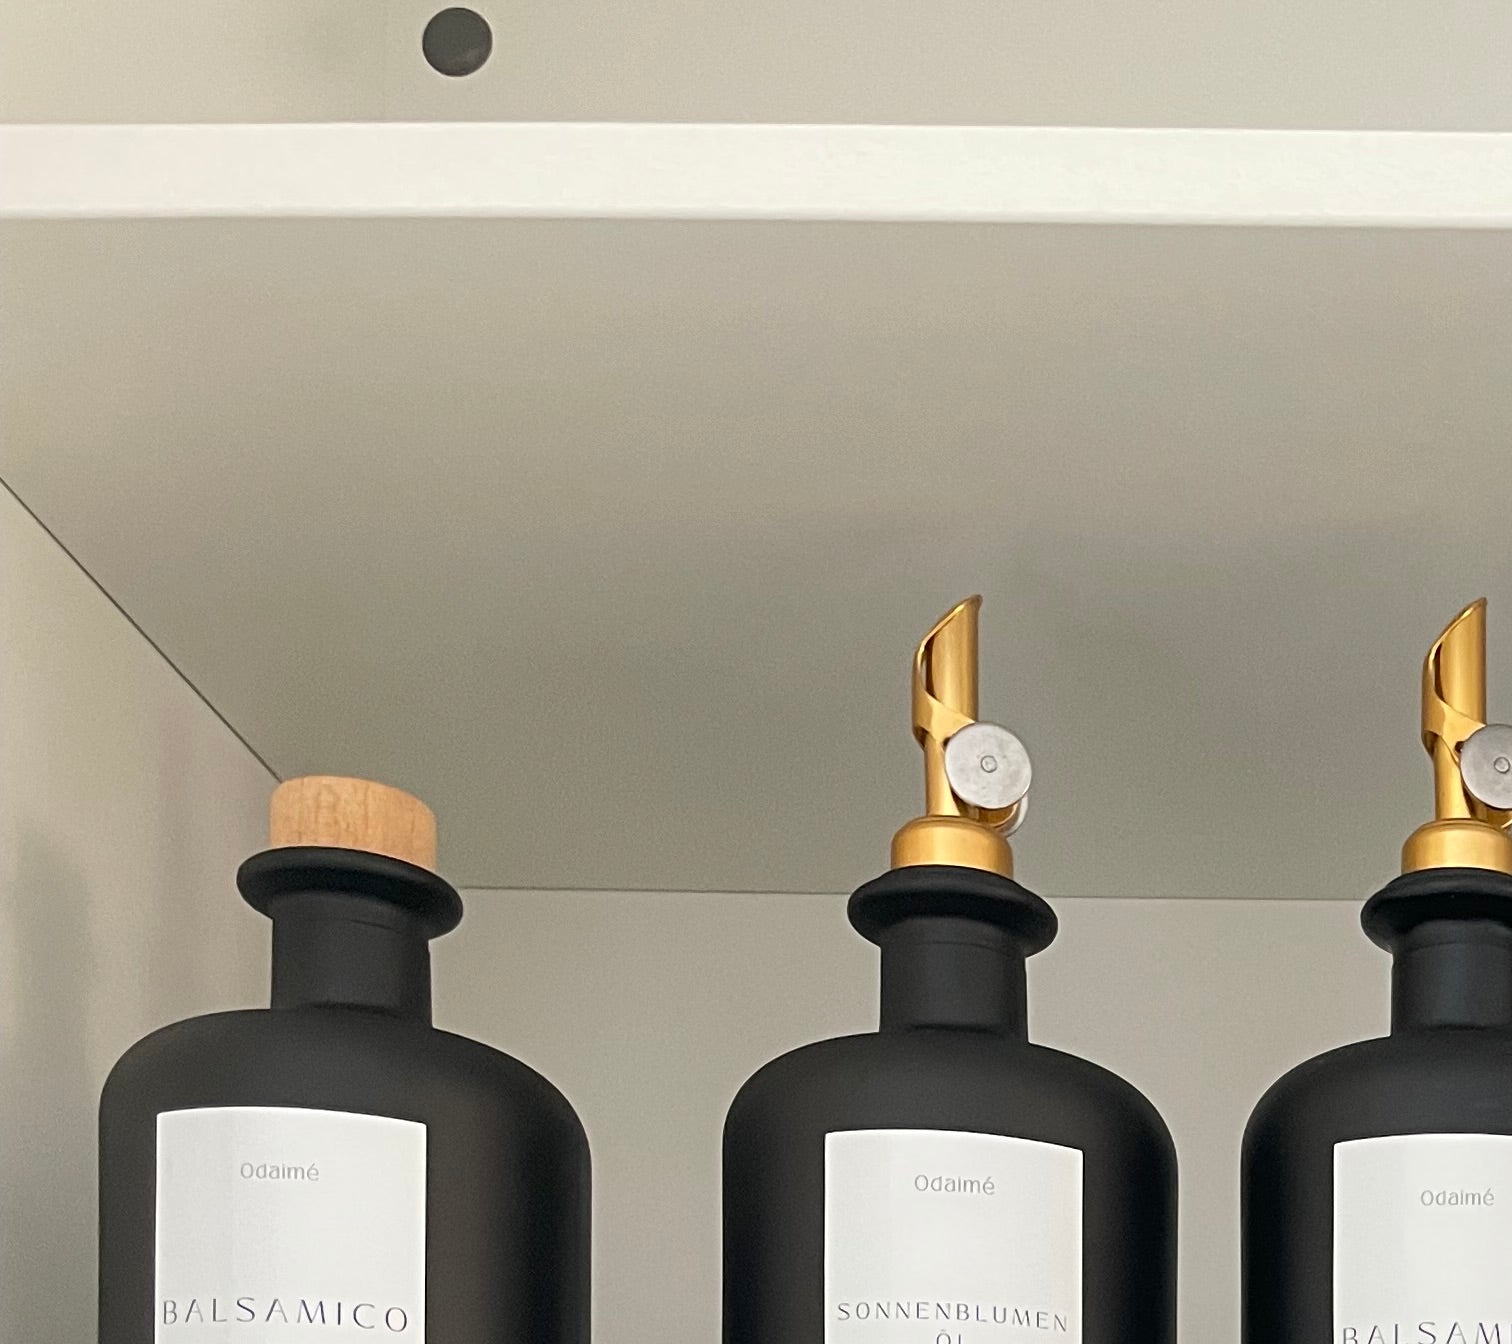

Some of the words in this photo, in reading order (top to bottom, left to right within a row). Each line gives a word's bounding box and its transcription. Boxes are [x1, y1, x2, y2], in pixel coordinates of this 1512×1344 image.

[239, 1160, 321, 1183] Odaimé
[915, 1175, 995, 1195] Odaimé
[1421, 1188, 1494, 1206] Odaimé
[161, 1294, 410, 1335] BALSAMICO
[837, 1300, 1068, 1333] SONNENBLUMEN
